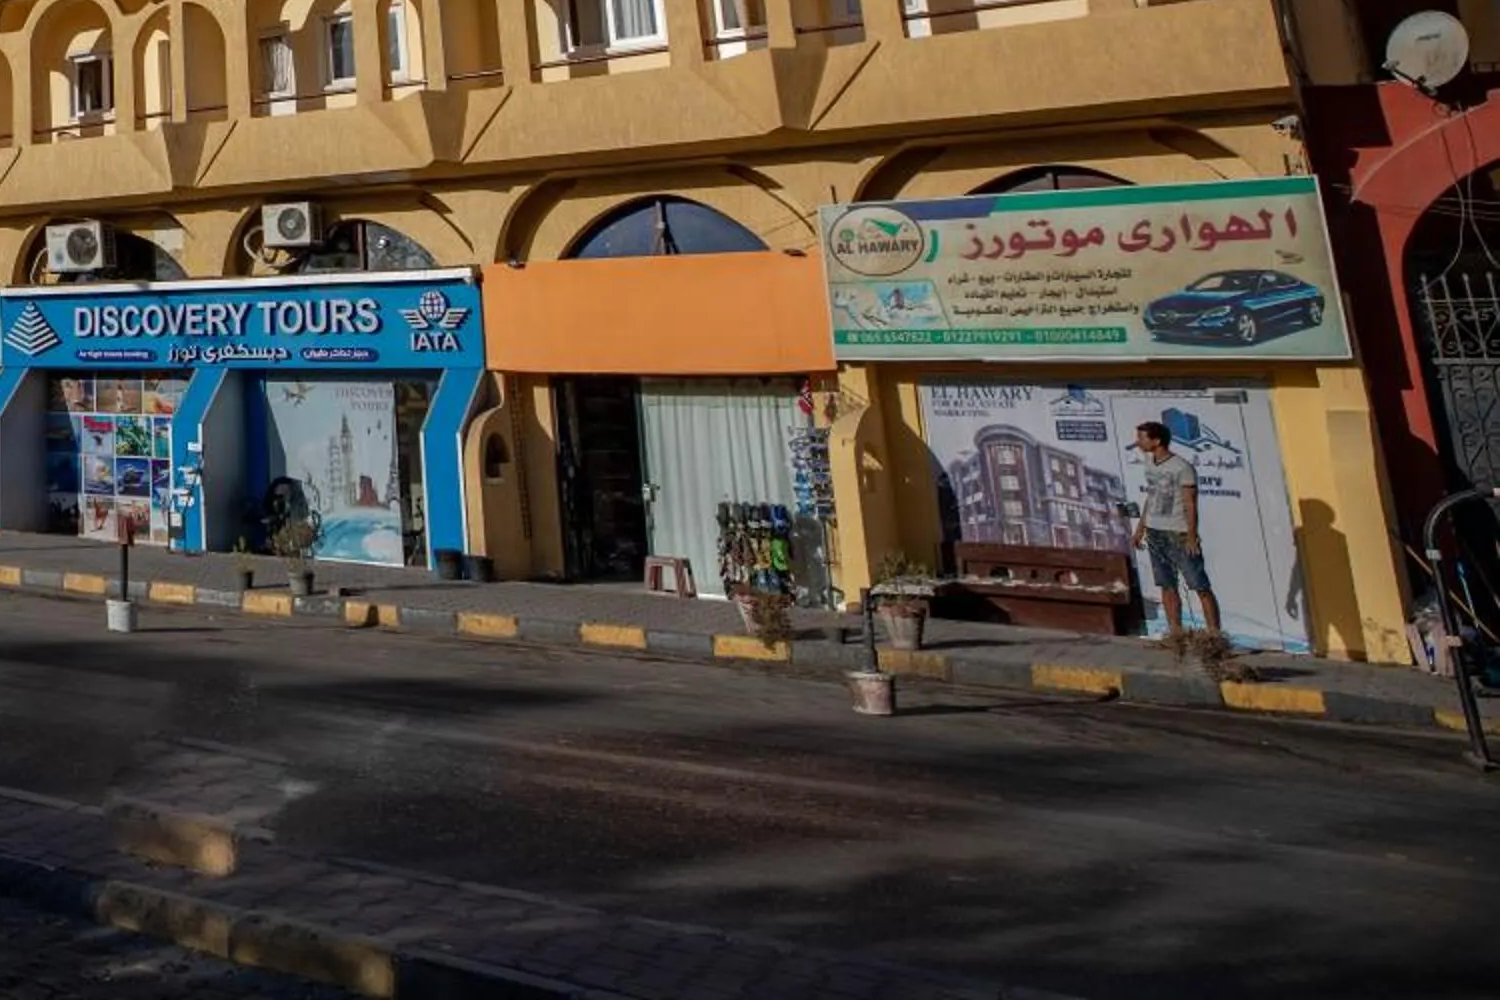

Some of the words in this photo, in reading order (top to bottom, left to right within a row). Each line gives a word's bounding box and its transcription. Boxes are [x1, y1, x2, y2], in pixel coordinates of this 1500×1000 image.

[836, 241, 854, 255] AL
[858, 240, 920, 254] HAWARY
[960, 219, 1105, 260] موتورز
[73, 304, 246, 338] DISCOVERY
[259, 298, 380, 334] TOURS
[410, 332, 459, 352] IATA
[957, 384, 1033, 401] HAWARY
